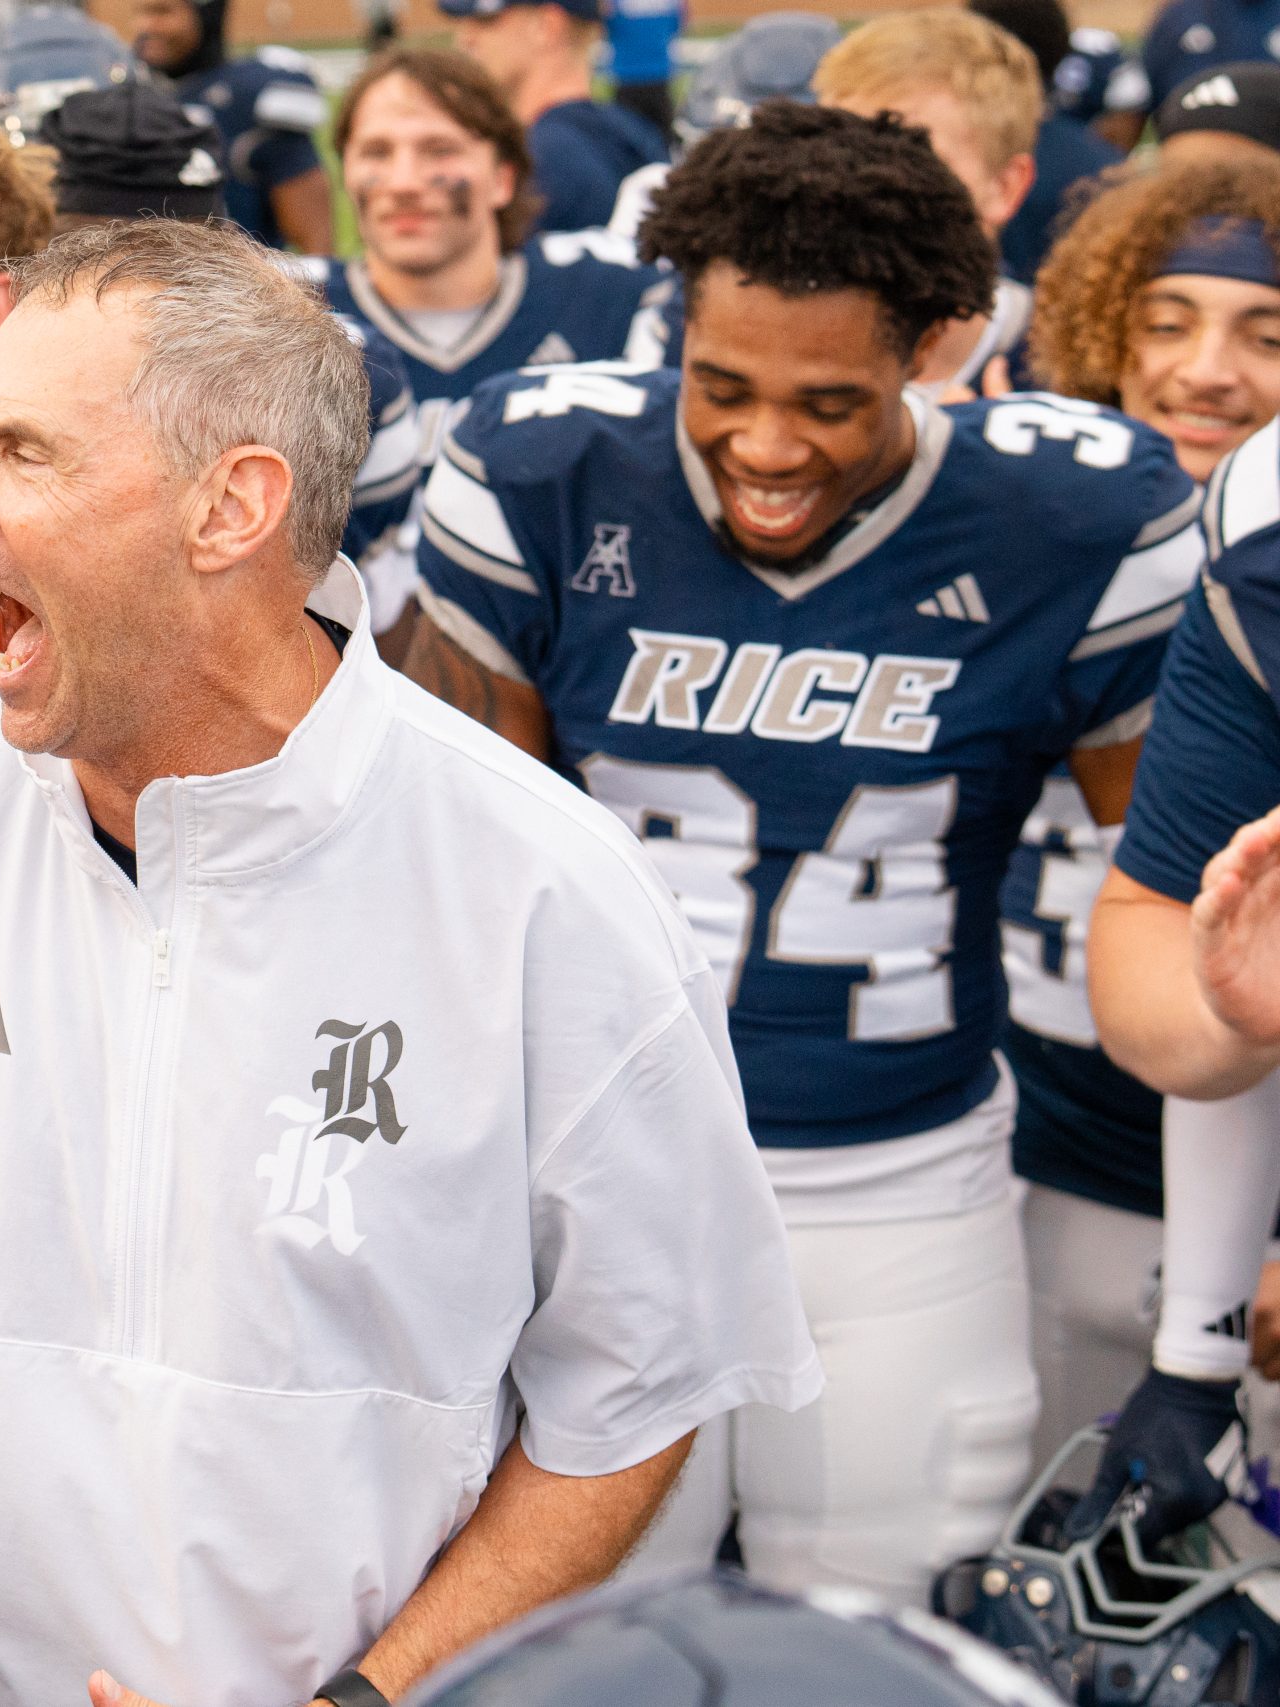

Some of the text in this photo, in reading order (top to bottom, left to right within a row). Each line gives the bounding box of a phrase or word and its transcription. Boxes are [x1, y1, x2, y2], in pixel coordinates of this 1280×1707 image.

[571, 523, 636, 598] A
[608, 627, 962, 753] RICE
[575, 751, 960, 1042] 34
[311, 1018, 409, 1145] R
[252, 1094, 368, 1257] R
